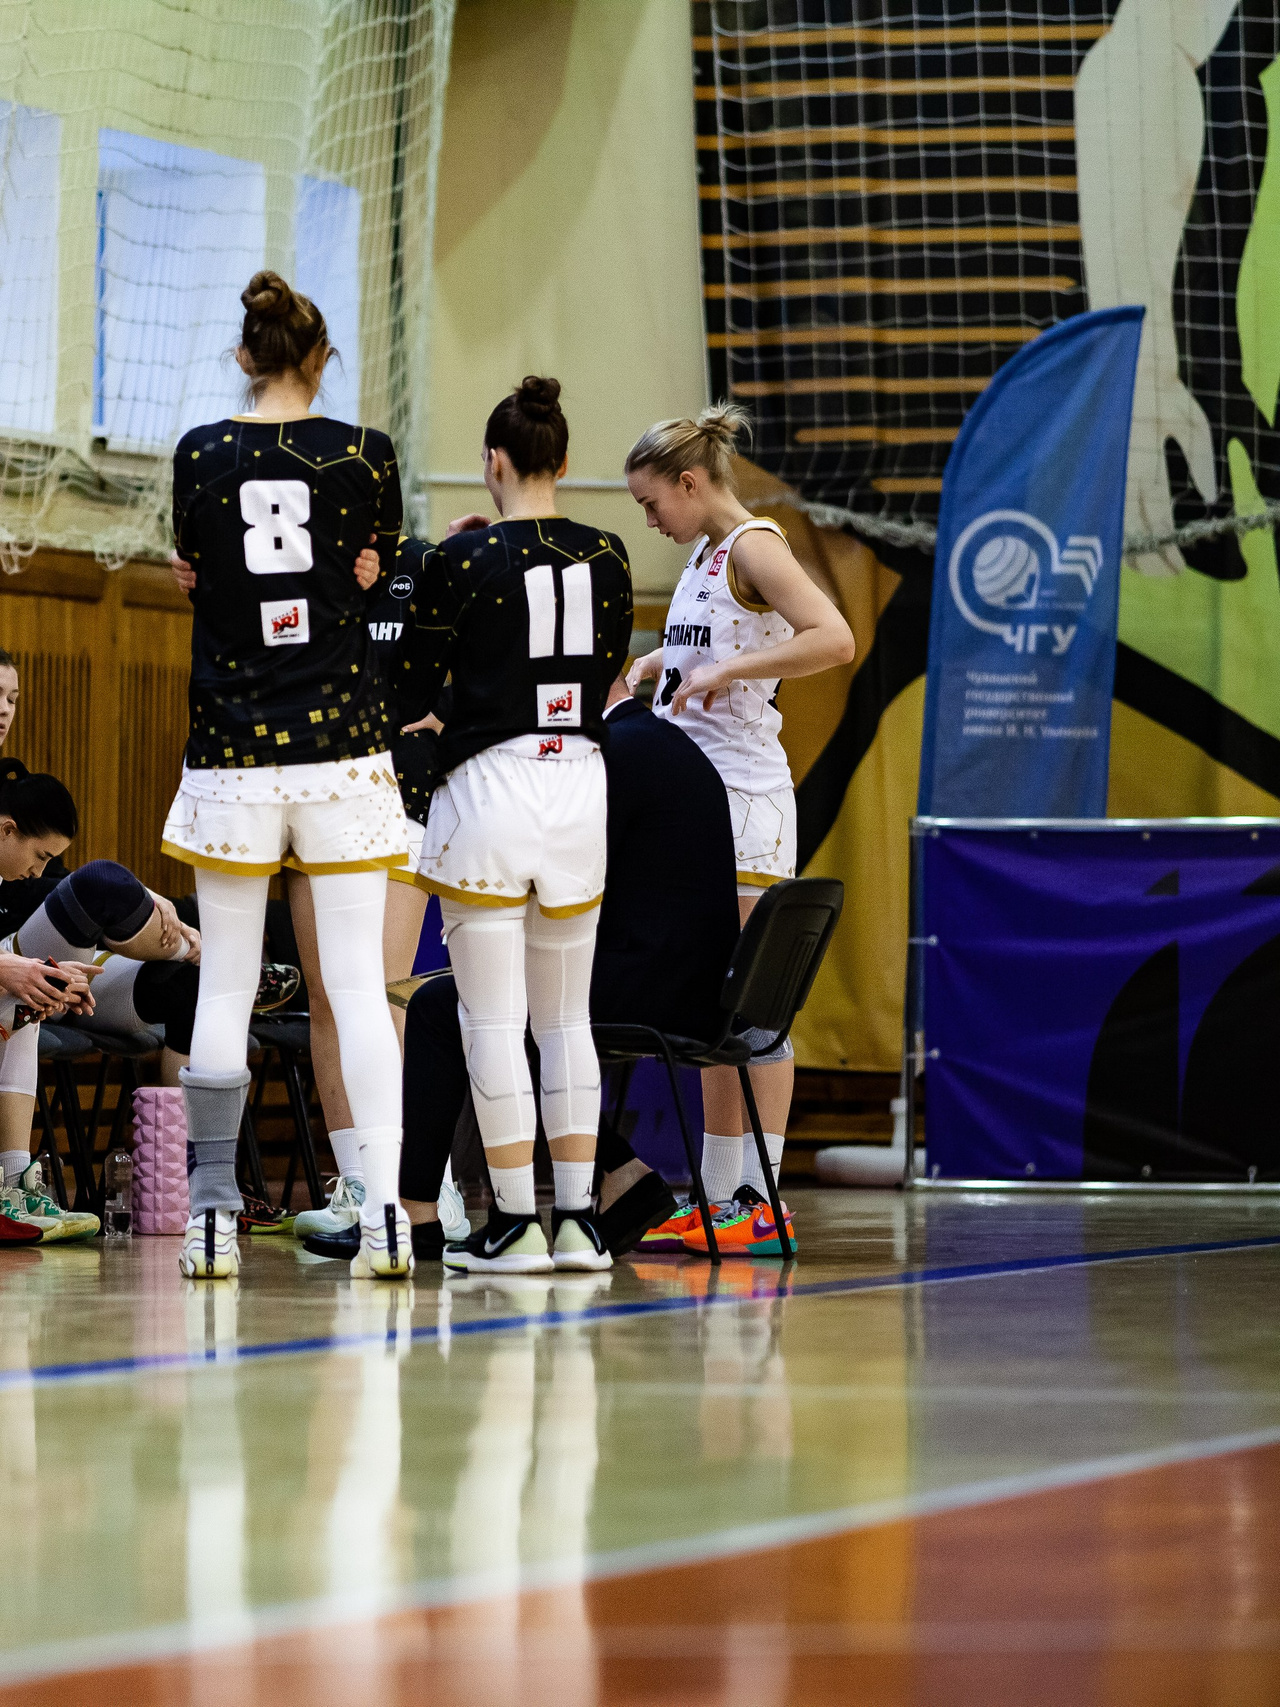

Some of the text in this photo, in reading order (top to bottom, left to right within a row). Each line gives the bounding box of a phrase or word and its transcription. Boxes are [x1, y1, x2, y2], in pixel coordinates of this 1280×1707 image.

[239, 479, 314, 575] 8
[392, 583, 411, 591] РФБ
[524, 562, 594, 659] 11
[1002, 624, 1078, 654] ЧГУ
[546, 690, 572, 717] NRJ
